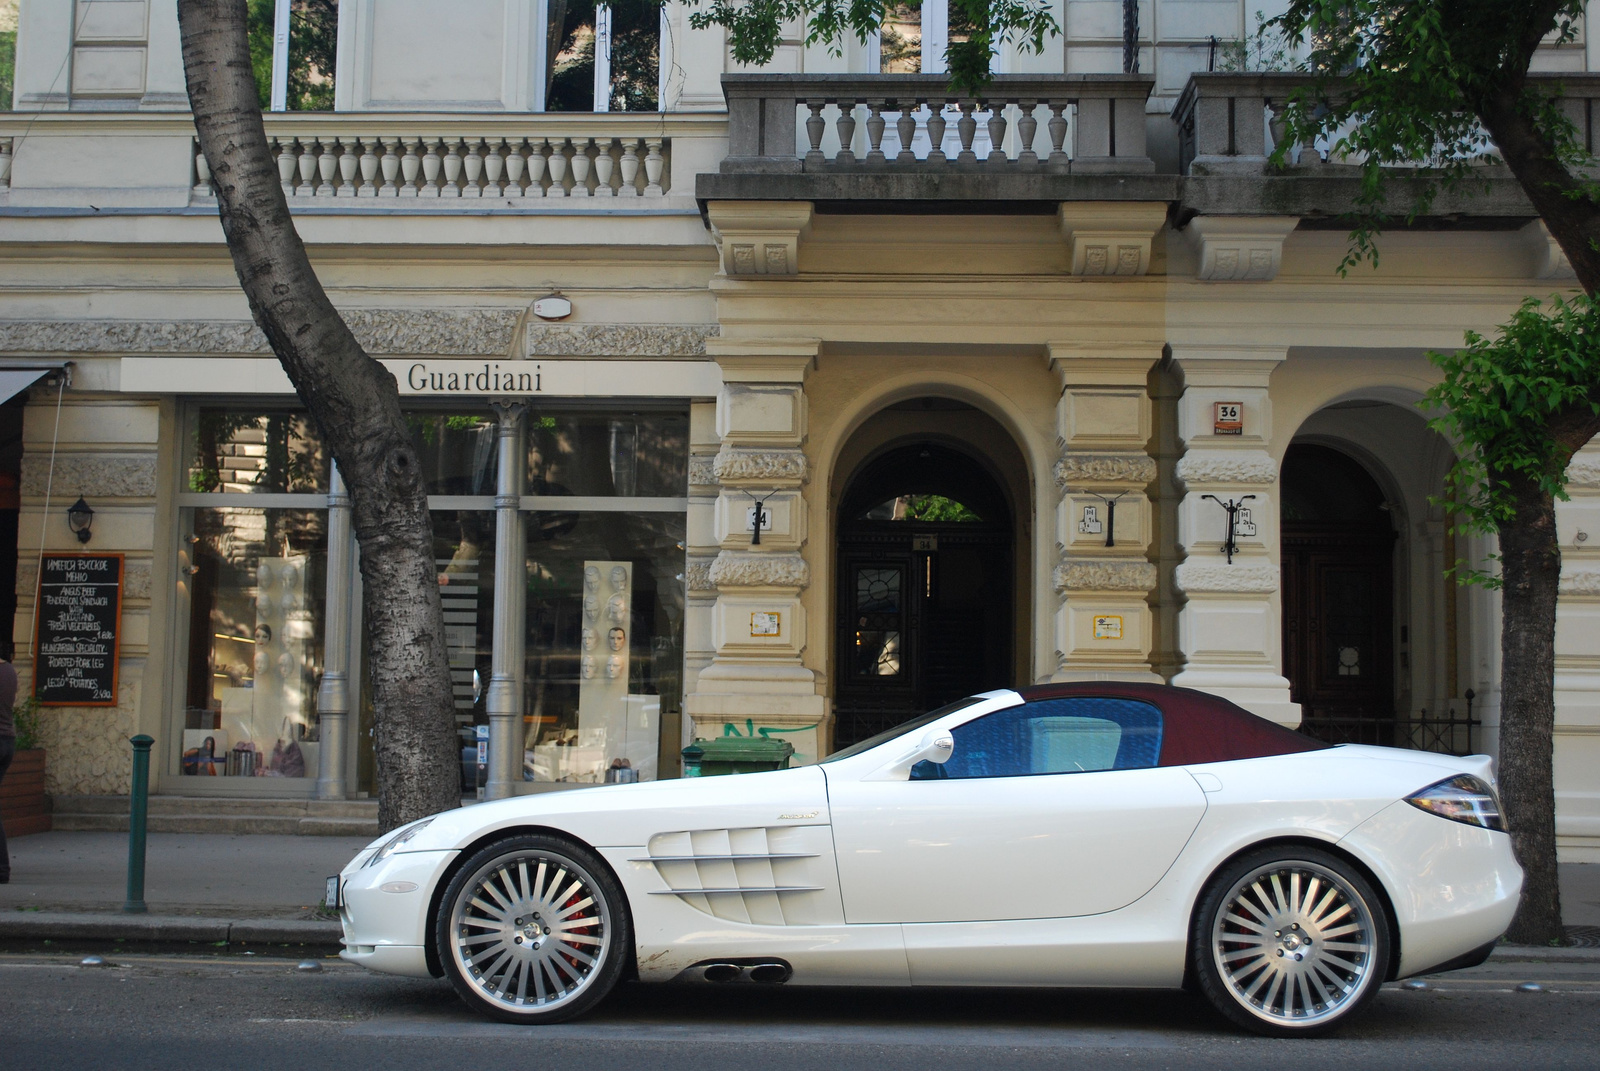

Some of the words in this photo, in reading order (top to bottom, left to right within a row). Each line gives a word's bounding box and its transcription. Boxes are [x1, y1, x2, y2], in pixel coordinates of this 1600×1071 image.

[407, 363, 543, 392] Guardiani
[1220, 406, 1237, 417] 36
[919, 540, 930, 549] 34
[65, 571, 88, 582] МЕНЮ
[81, 587, 97, 596] BEEF
[79, 596, 108, 606] SANDWICH
[47, 620, 67, 631] FRESH
[67, 621, 101, 631] VEGETABLES
[41, 642, 75, 653] HUNGARIAN
[48, 656, 75, 668] ROASTED
[75, 656, 91, 668] PORK
[92, 657, 105, 668] LEG
[66, 667, 83, 678] WITH
[69, 677, 99, 689] POTATOES
